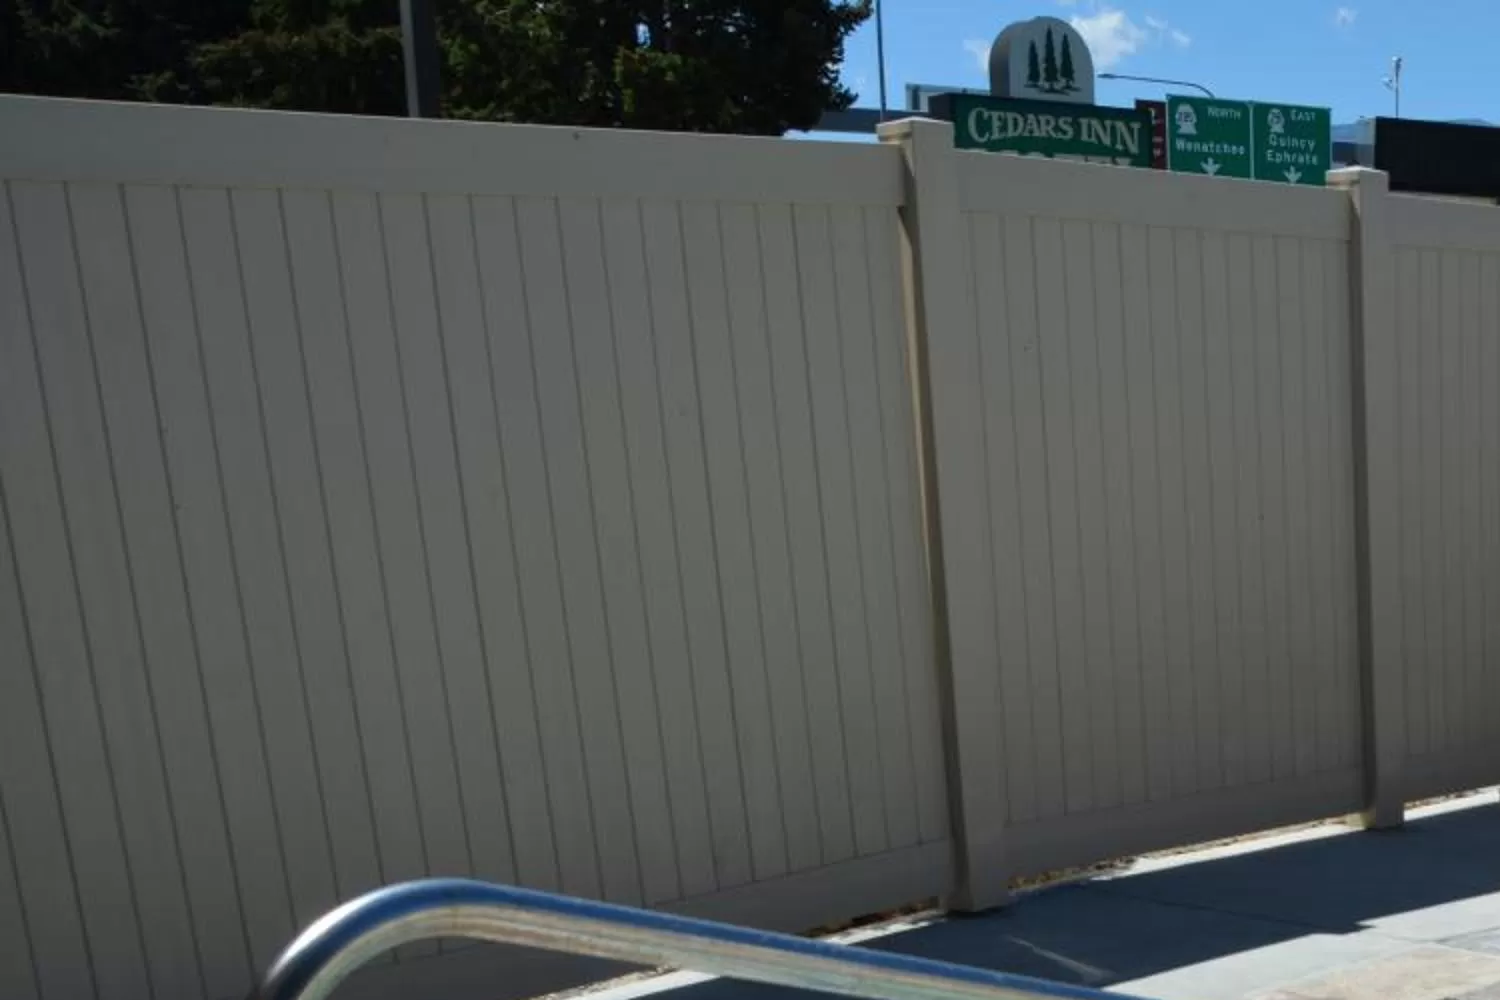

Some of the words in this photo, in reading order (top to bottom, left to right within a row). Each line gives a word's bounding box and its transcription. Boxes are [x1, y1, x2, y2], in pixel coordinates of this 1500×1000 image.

[1207, 106, 1242, 120] NORTH
[1289, 108, 1316, 121] EAST
[967, 107, 1075, 144] CEDARS
[1079, 117, 1142, 155] INN
[1175, 137, 1246, 156] Wenatchee
[1268, 134, 1316, 151] Quincy
